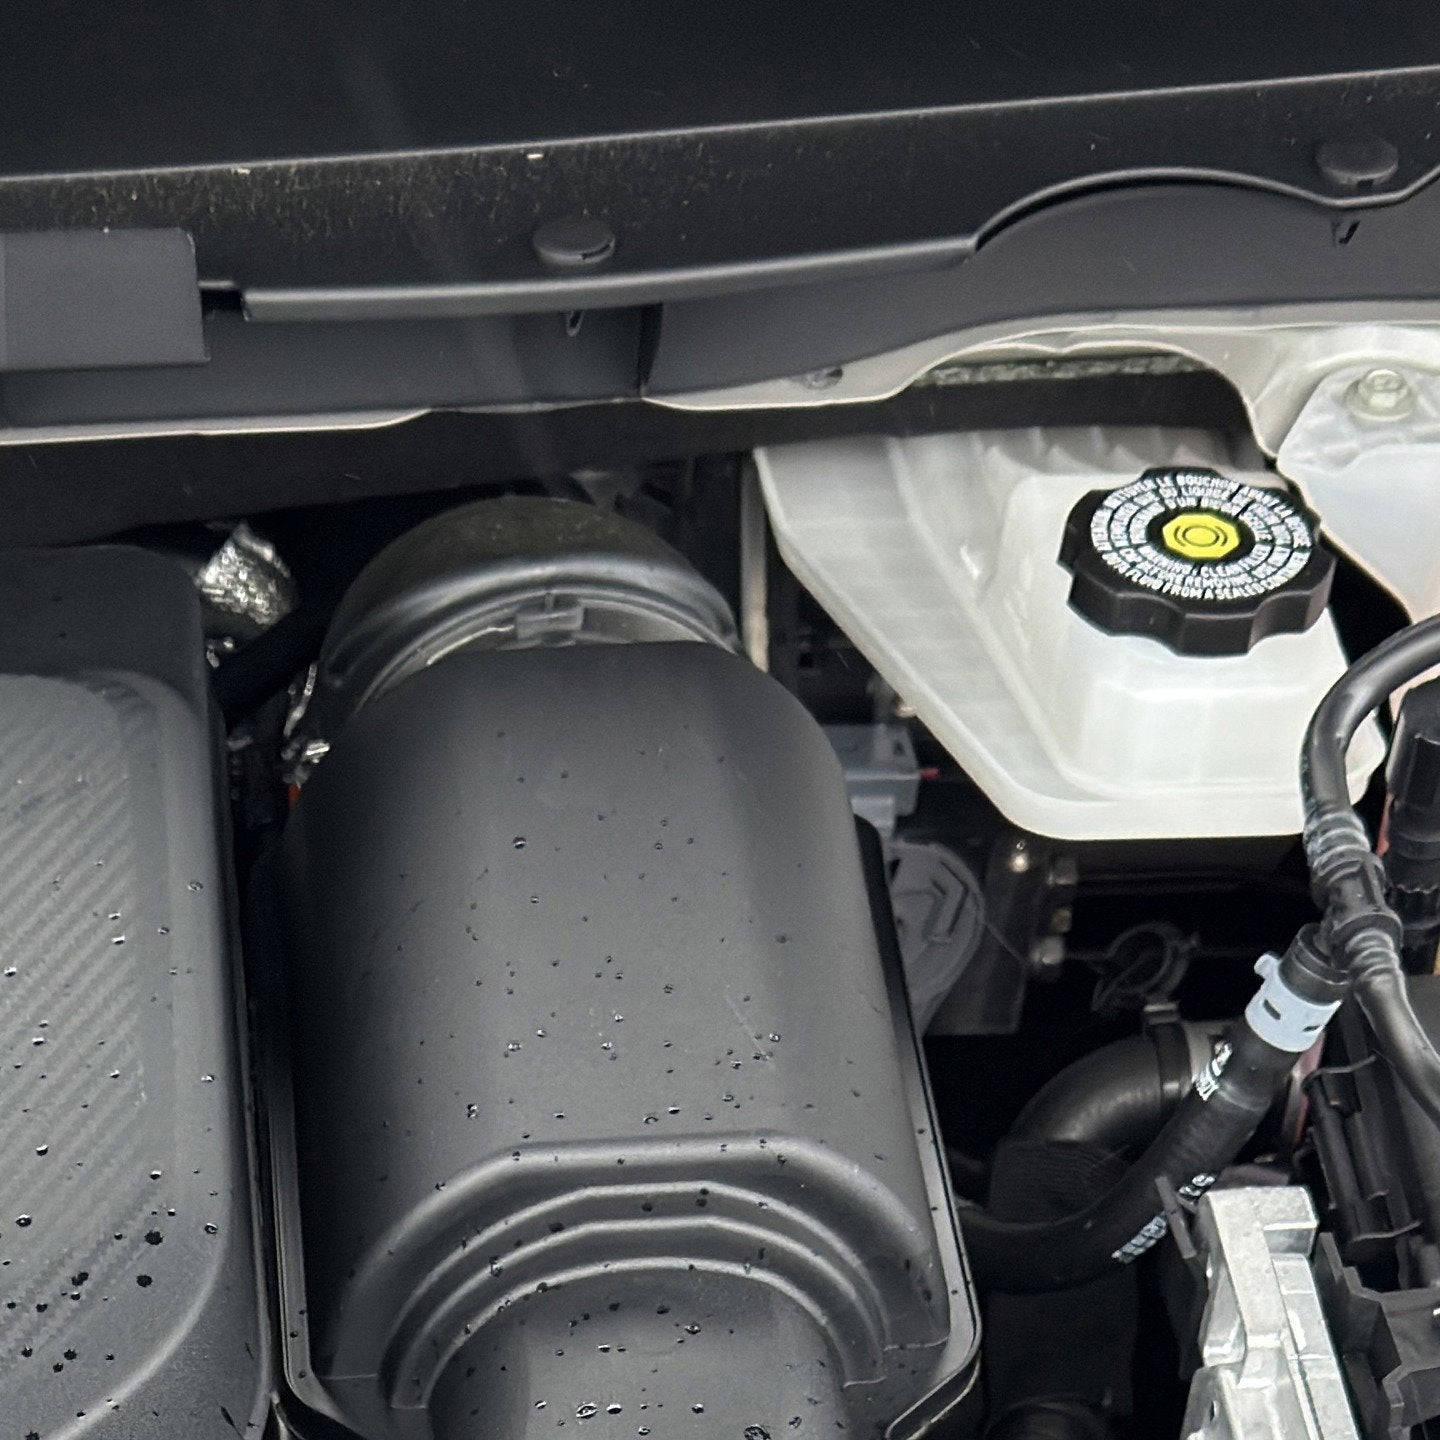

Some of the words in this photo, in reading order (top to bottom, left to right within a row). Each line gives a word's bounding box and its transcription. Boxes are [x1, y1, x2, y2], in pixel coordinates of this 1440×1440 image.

[1176, 473, 1240, 490] BOUCHON
[1162, 582, 1203, 599] FROM
[1204, 588, 1214, 599] A
